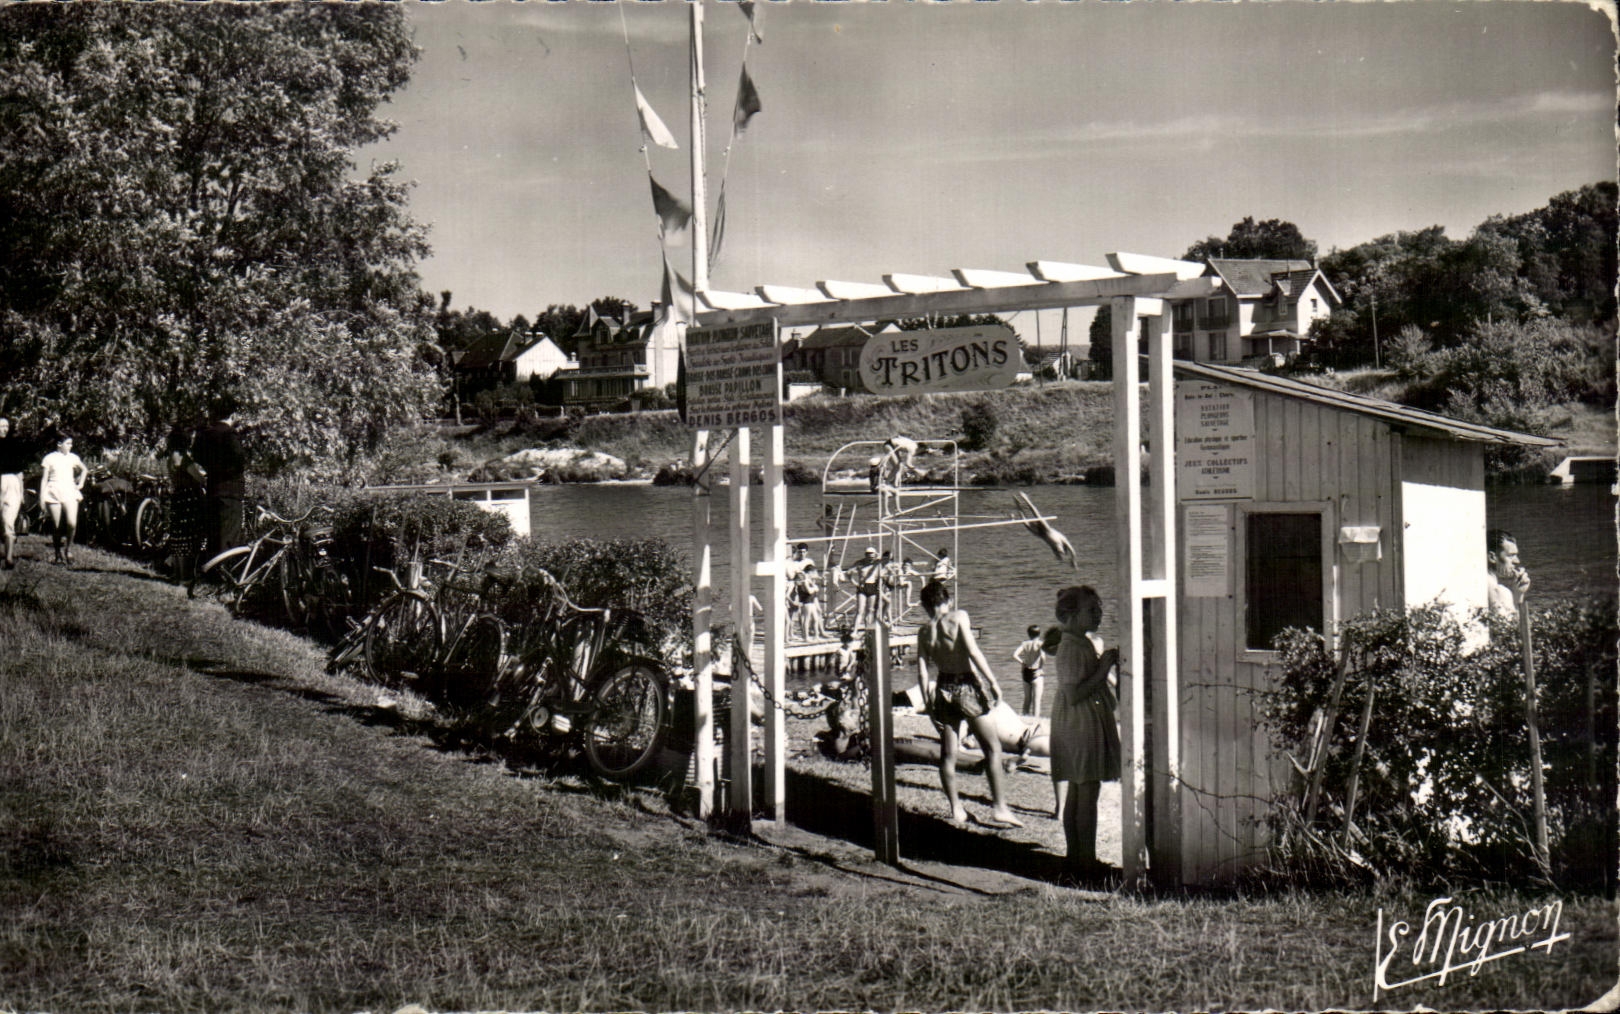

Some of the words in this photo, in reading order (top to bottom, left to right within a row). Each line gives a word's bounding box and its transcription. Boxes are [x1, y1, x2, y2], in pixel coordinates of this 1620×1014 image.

[891, 339, 919, 353] LES
[871, 340, 1008, 386] TRITONS
[725, 380, 761, 394] PAPILLON
[688, 414, 722, 427] DENIS
[727, 409, 776, 425] BERGOS
[1206, 457, 1249, 467] COLLECTIFS
